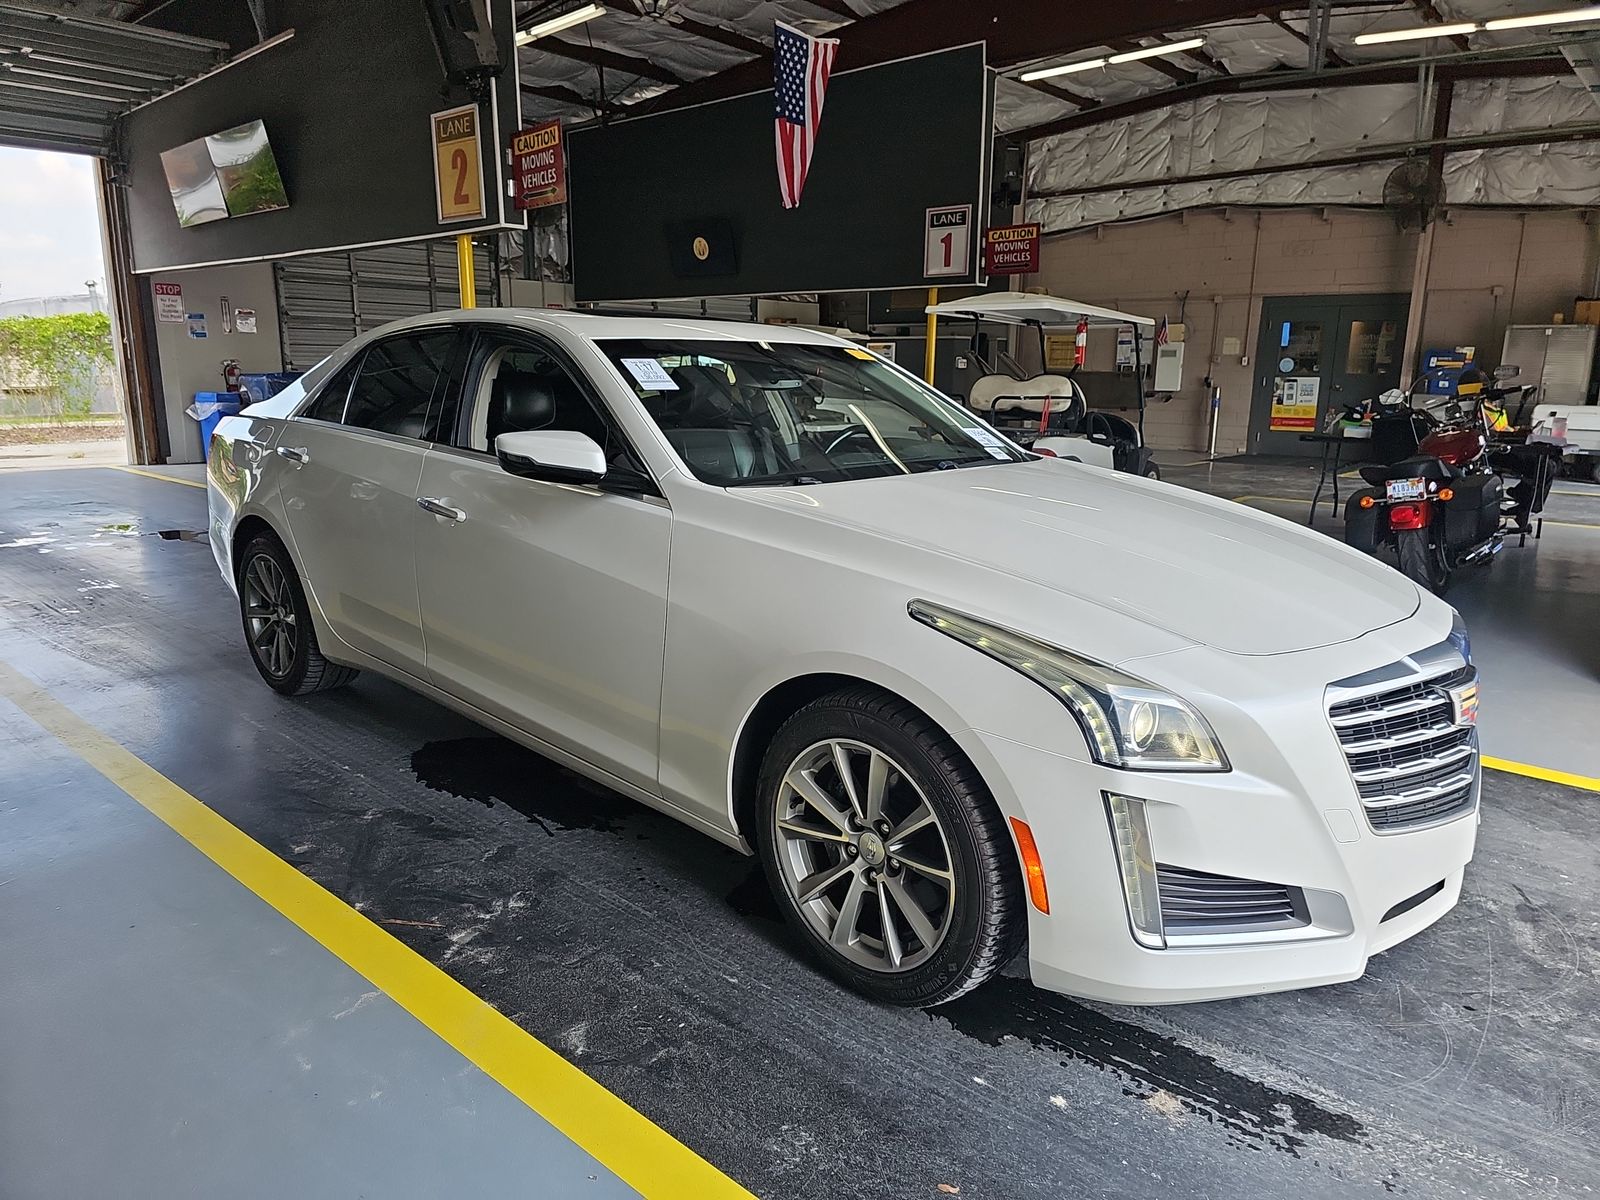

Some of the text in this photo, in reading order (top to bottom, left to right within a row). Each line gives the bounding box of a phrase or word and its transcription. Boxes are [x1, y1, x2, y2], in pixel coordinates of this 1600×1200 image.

[440, 117, 471, 138] LANE
[517, 128, 556, 152] CAUTION
[522, 149, 555, 171] MOVING
[451, 148, 469, 205] 2
[522, 168, 557, 189] VEHICLES
[933, 212, 963, 225] LANE
[992, 228, 1034, 241] CAUTION
[940, 232, 952, 267] 1
[994, 240, 1030, 252] MOVING
[993, 252, 1031, 263] VEHICLES
[155, 284, 180, 295] STOP
